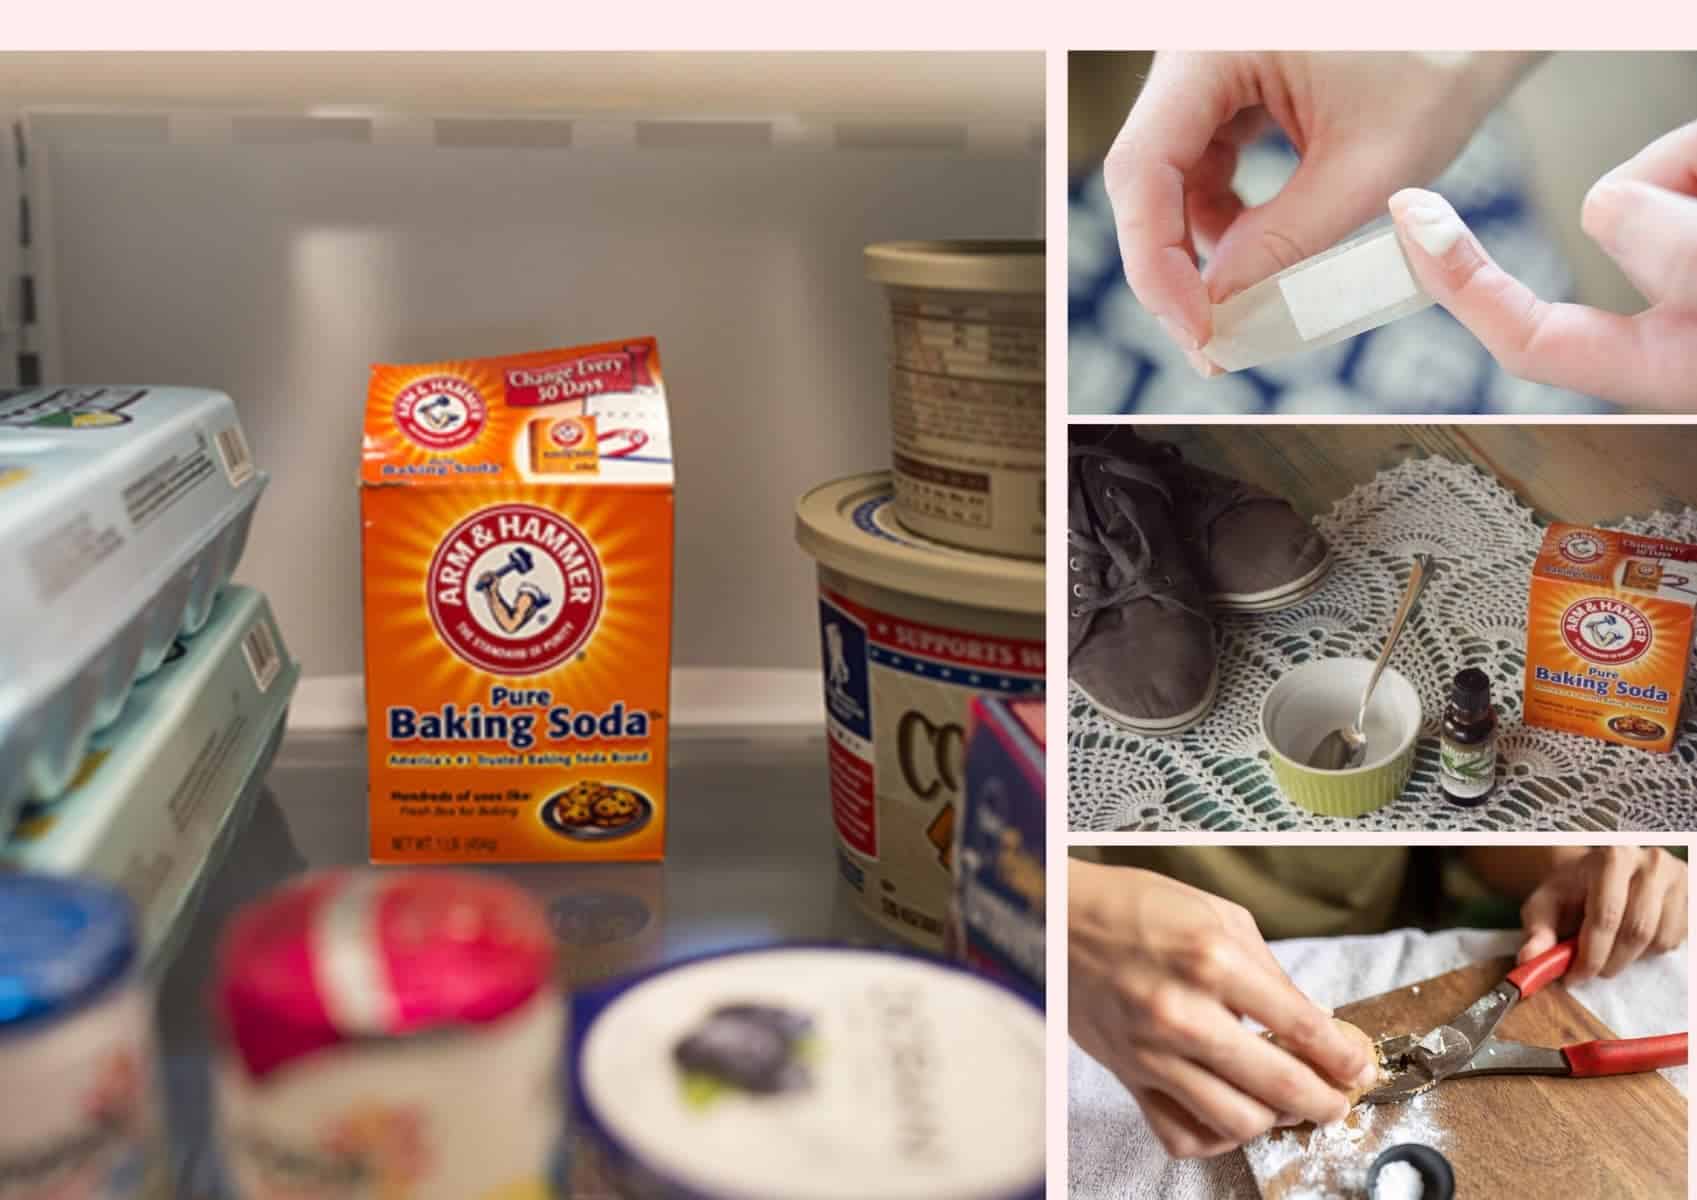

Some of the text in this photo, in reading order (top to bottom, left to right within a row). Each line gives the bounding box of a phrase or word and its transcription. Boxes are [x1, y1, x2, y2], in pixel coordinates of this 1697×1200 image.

[508, 358, 622, 387] Change Every
[563, 378, 604, 398] Days
[438, 515, 593, 606] ARM & HAMMER
[1566, 601, 1647, 642] ARM & HAMMER
[895, 622, 1015, 665] SUPPORTS
[1536, 667, 1608, 695] Baking
[1616, 681, 1668, 702] Soda
[1588, 667, 1619, 679] Pure
[491, 686, 552, 707] Pure
[388, 703, 648, 748] Baking Soda
[527, 753, 571, 767] Baking
[575, 752, 607, 763] Soda
[610, 751, 649, 763] Brand
